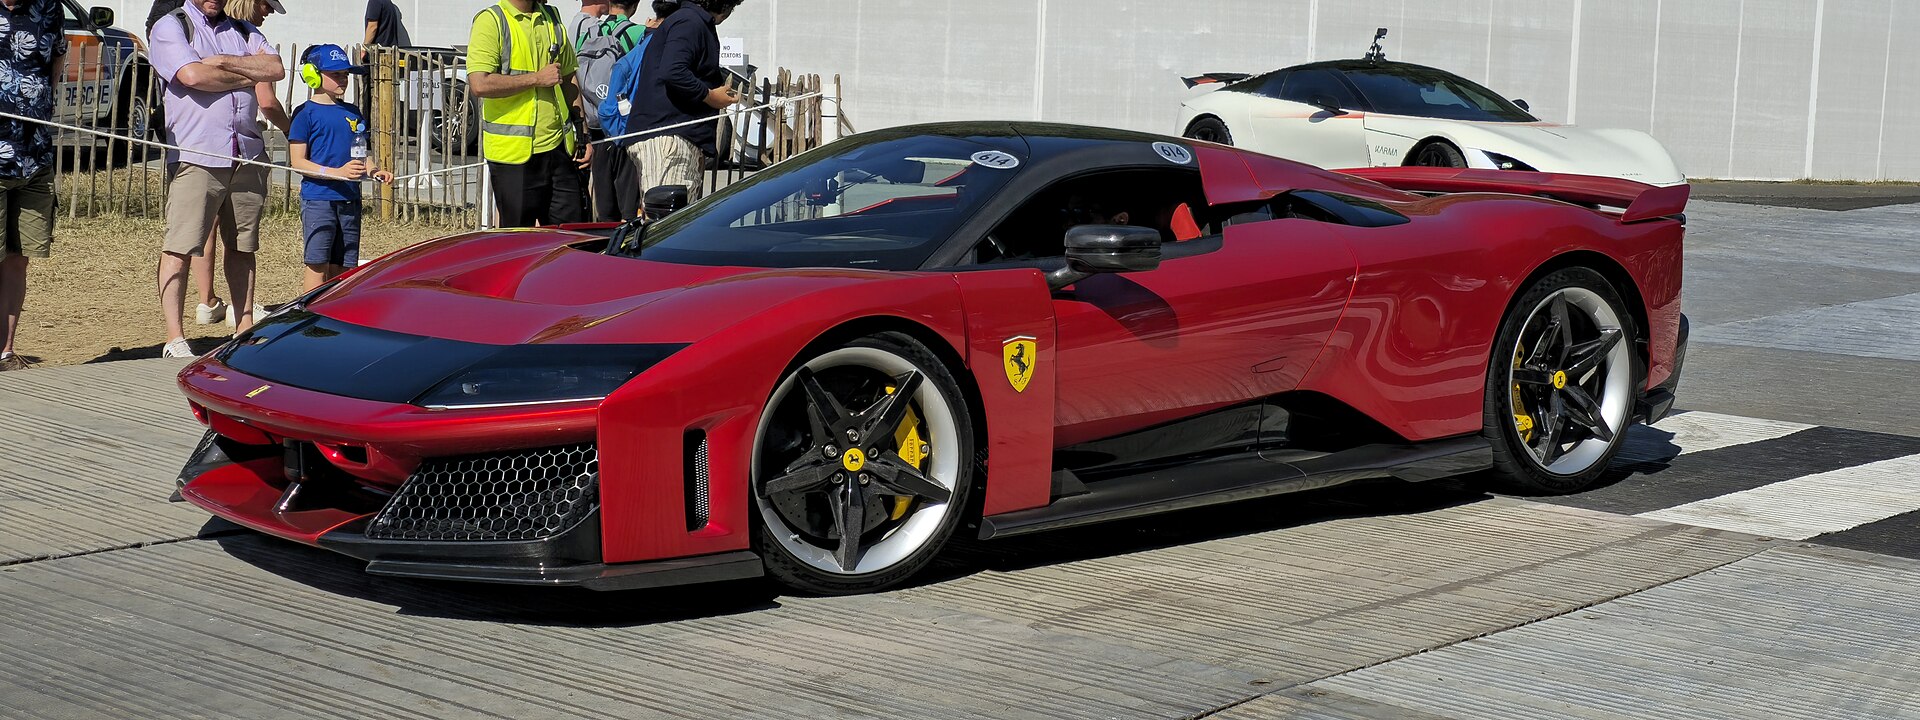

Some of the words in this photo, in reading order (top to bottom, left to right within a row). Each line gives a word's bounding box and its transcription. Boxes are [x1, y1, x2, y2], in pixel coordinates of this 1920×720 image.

[1161, 145, 1185, 158] 614
[1374, 145, 1398, 156] KARMA
[979, 154, 1010, 165] 614
